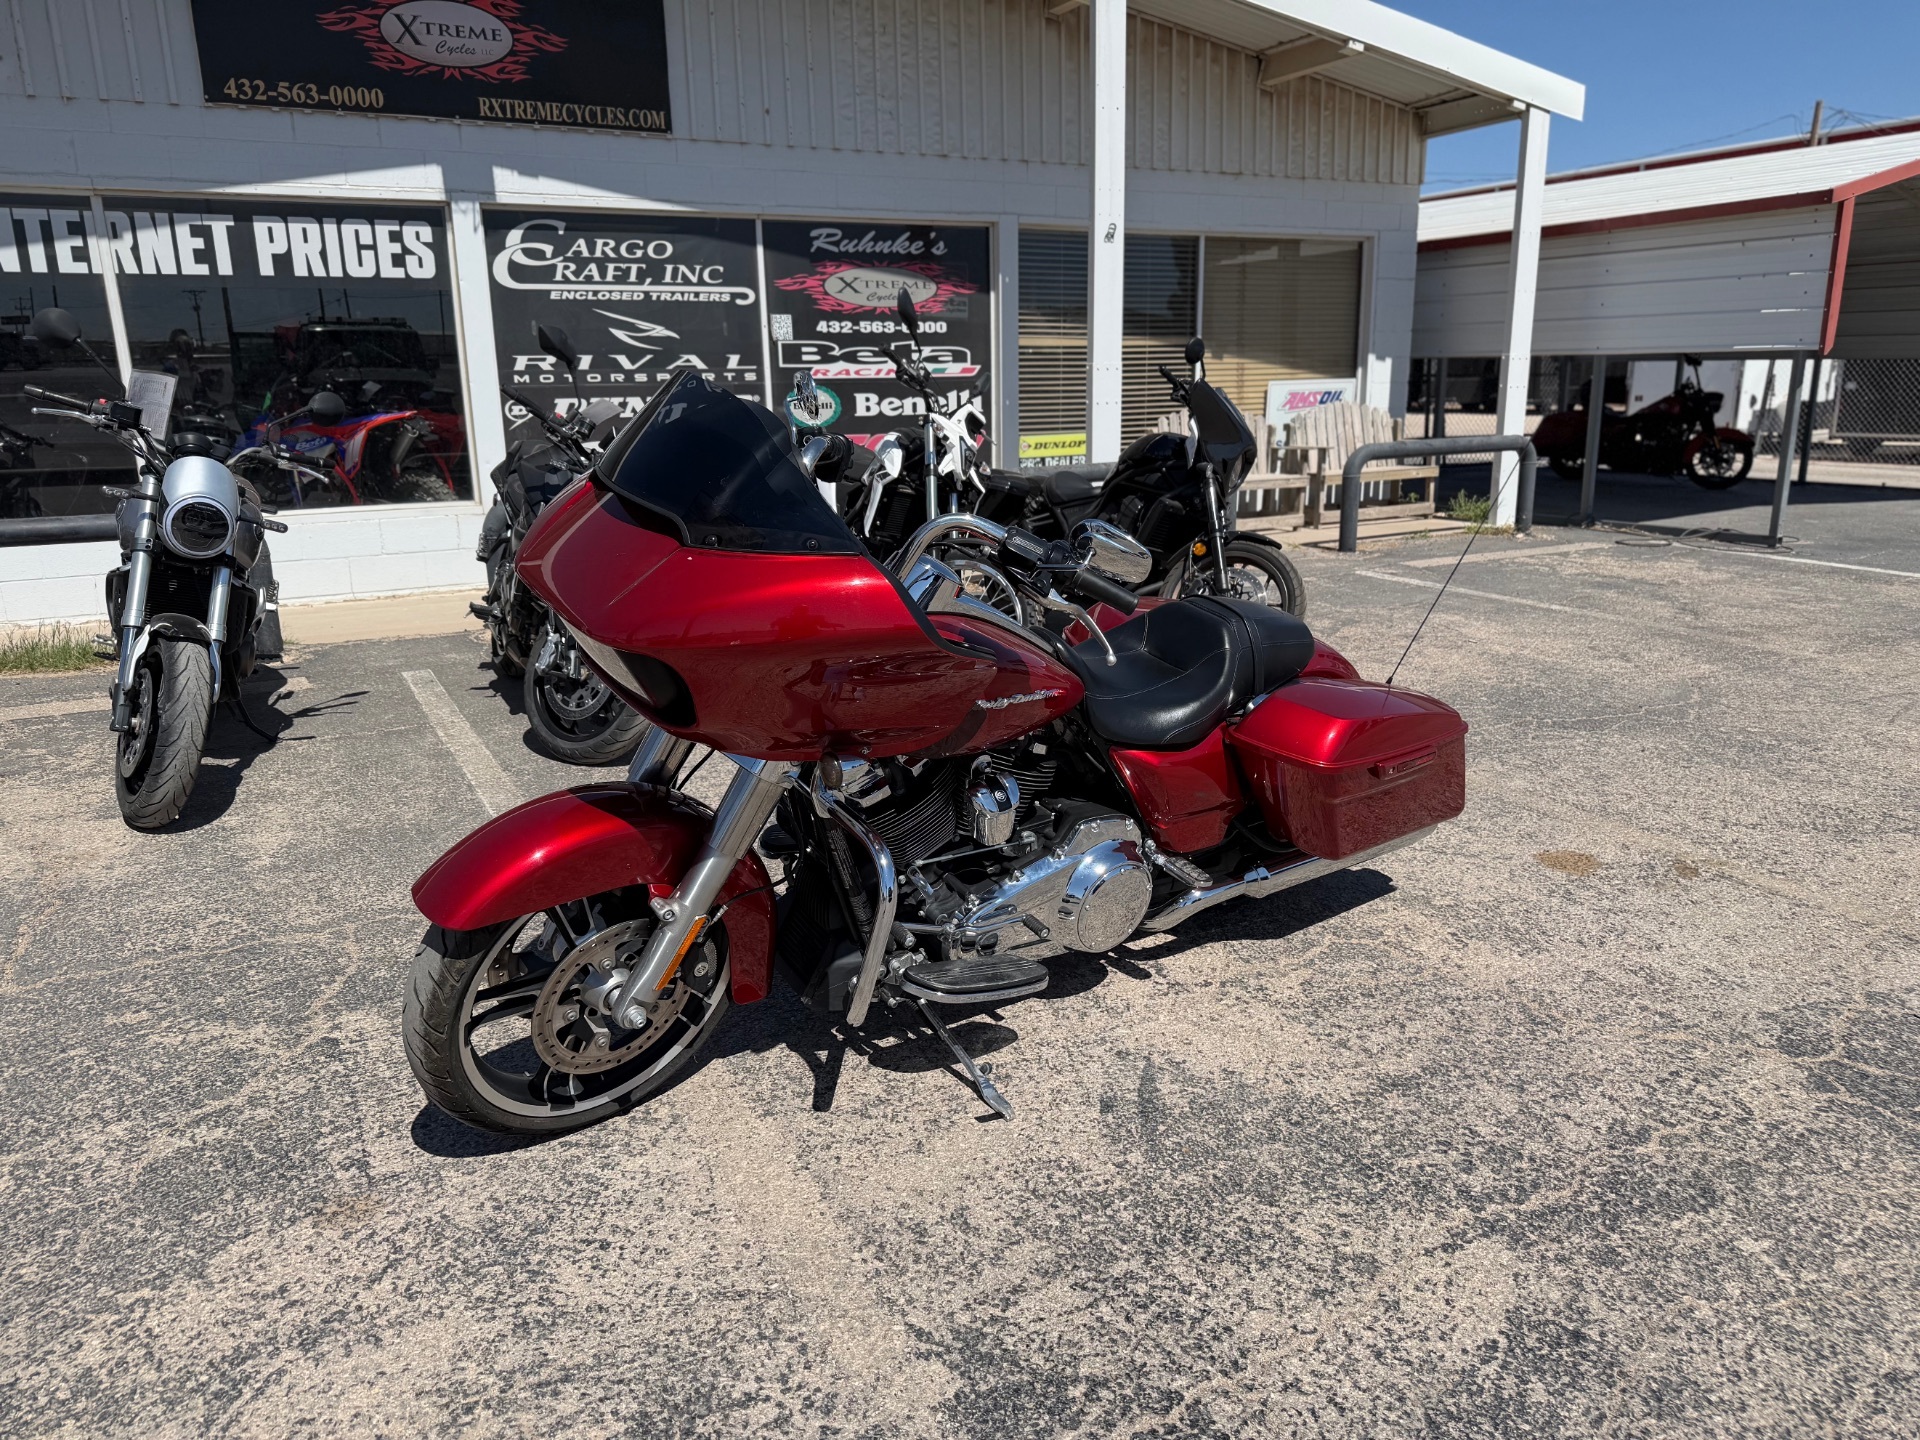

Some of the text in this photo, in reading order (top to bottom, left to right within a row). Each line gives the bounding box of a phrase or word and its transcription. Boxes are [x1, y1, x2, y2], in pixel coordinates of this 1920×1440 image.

[390, 13, 503, 46] XTREME
[435, 39, 477, 56] Cycles
[223, 77, 385, 109] 432-563-0000
[478, 96, 667, 129] RXTREMECYCLES.COM
[252, 215, 437, 279] PRICES
[505, 219, 674, 266] CARGO
[809, 227, 948, 256] Ruhnke's
[662, 264, 725, 284] INC
[834, 276, 932, 294] XTREME
[550, 290, 731, 302] ENCLOSED TRAILERS
[866, 291, 898, 303] Cycle
[512, 353, 757, 371] RIVAL
[778, 340, 971, 367] Beta
[513, 372, 757, 384] MOTORSPRTS
[812, 367, 897, 377] RACI
[793, 401, 833, 410] Blli
[853, 389, 984, 417] Benelli
[1281, 390, 1344, 411] AMSOIL
[1033, 440, 1086, 450] DUNLOP
[1045, 455, 1086, 467] DEALER
